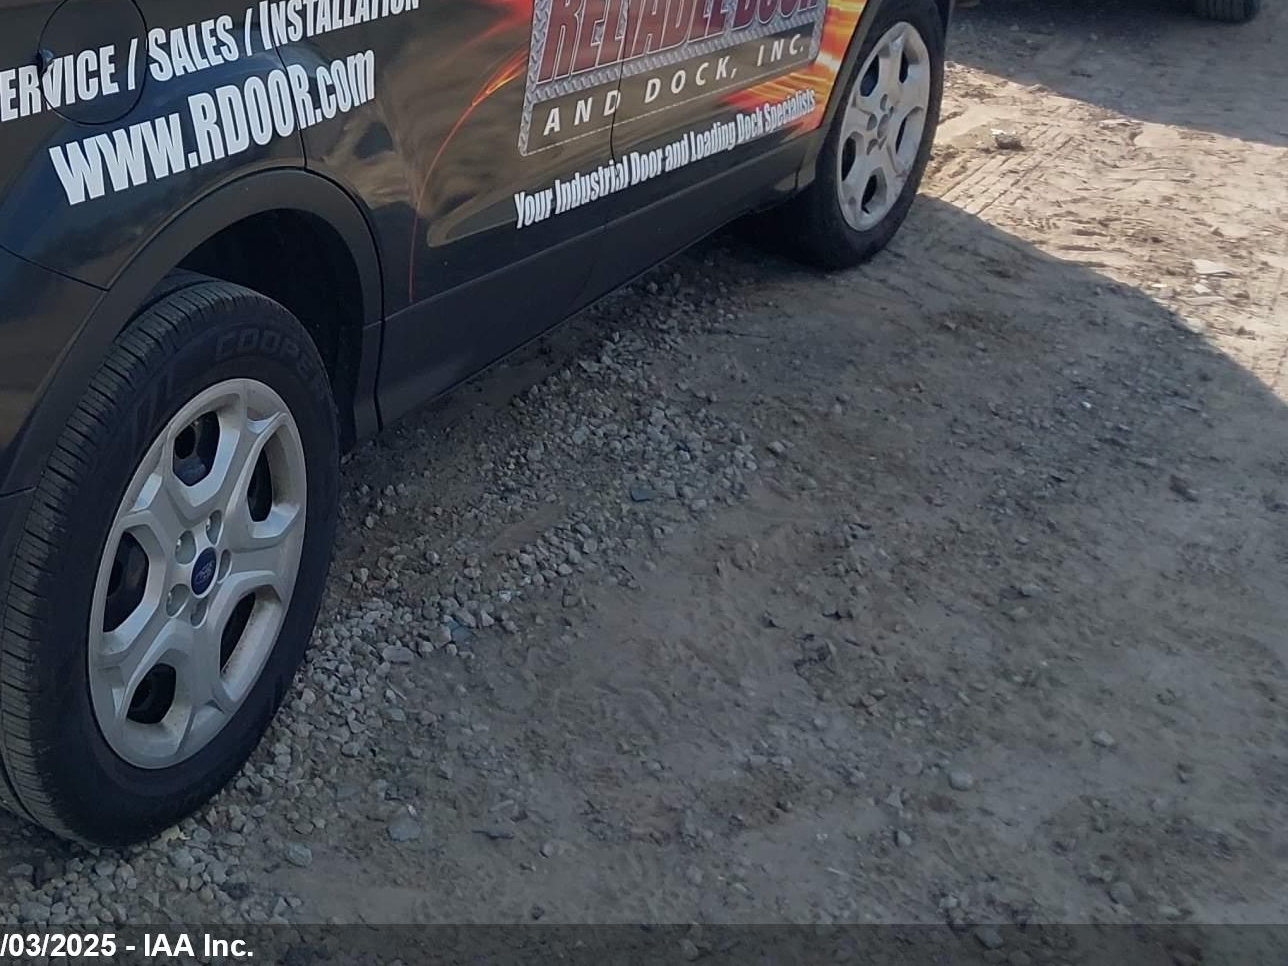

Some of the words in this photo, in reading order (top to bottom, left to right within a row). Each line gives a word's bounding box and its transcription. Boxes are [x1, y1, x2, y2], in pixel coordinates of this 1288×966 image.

[127, 37, 138, 91] /
[146, 14, 239, 82] SALES
[244, 7, 255, 57] /
[543, 89, 621, 136] AND
[644, 56, 737, 104] DOCK,
[756, 32, 805, 67] INC.
[514, 186, 554, 229] Your
[554, 156, 630, 215] Industrial
[630, 149, 664, 187] Door
[663, 133, 690, 170] and
[689, 117, 736, 160] Loading
[735, 110, 764, 141] Dock
[763, 86, 817, 134] Specialists
